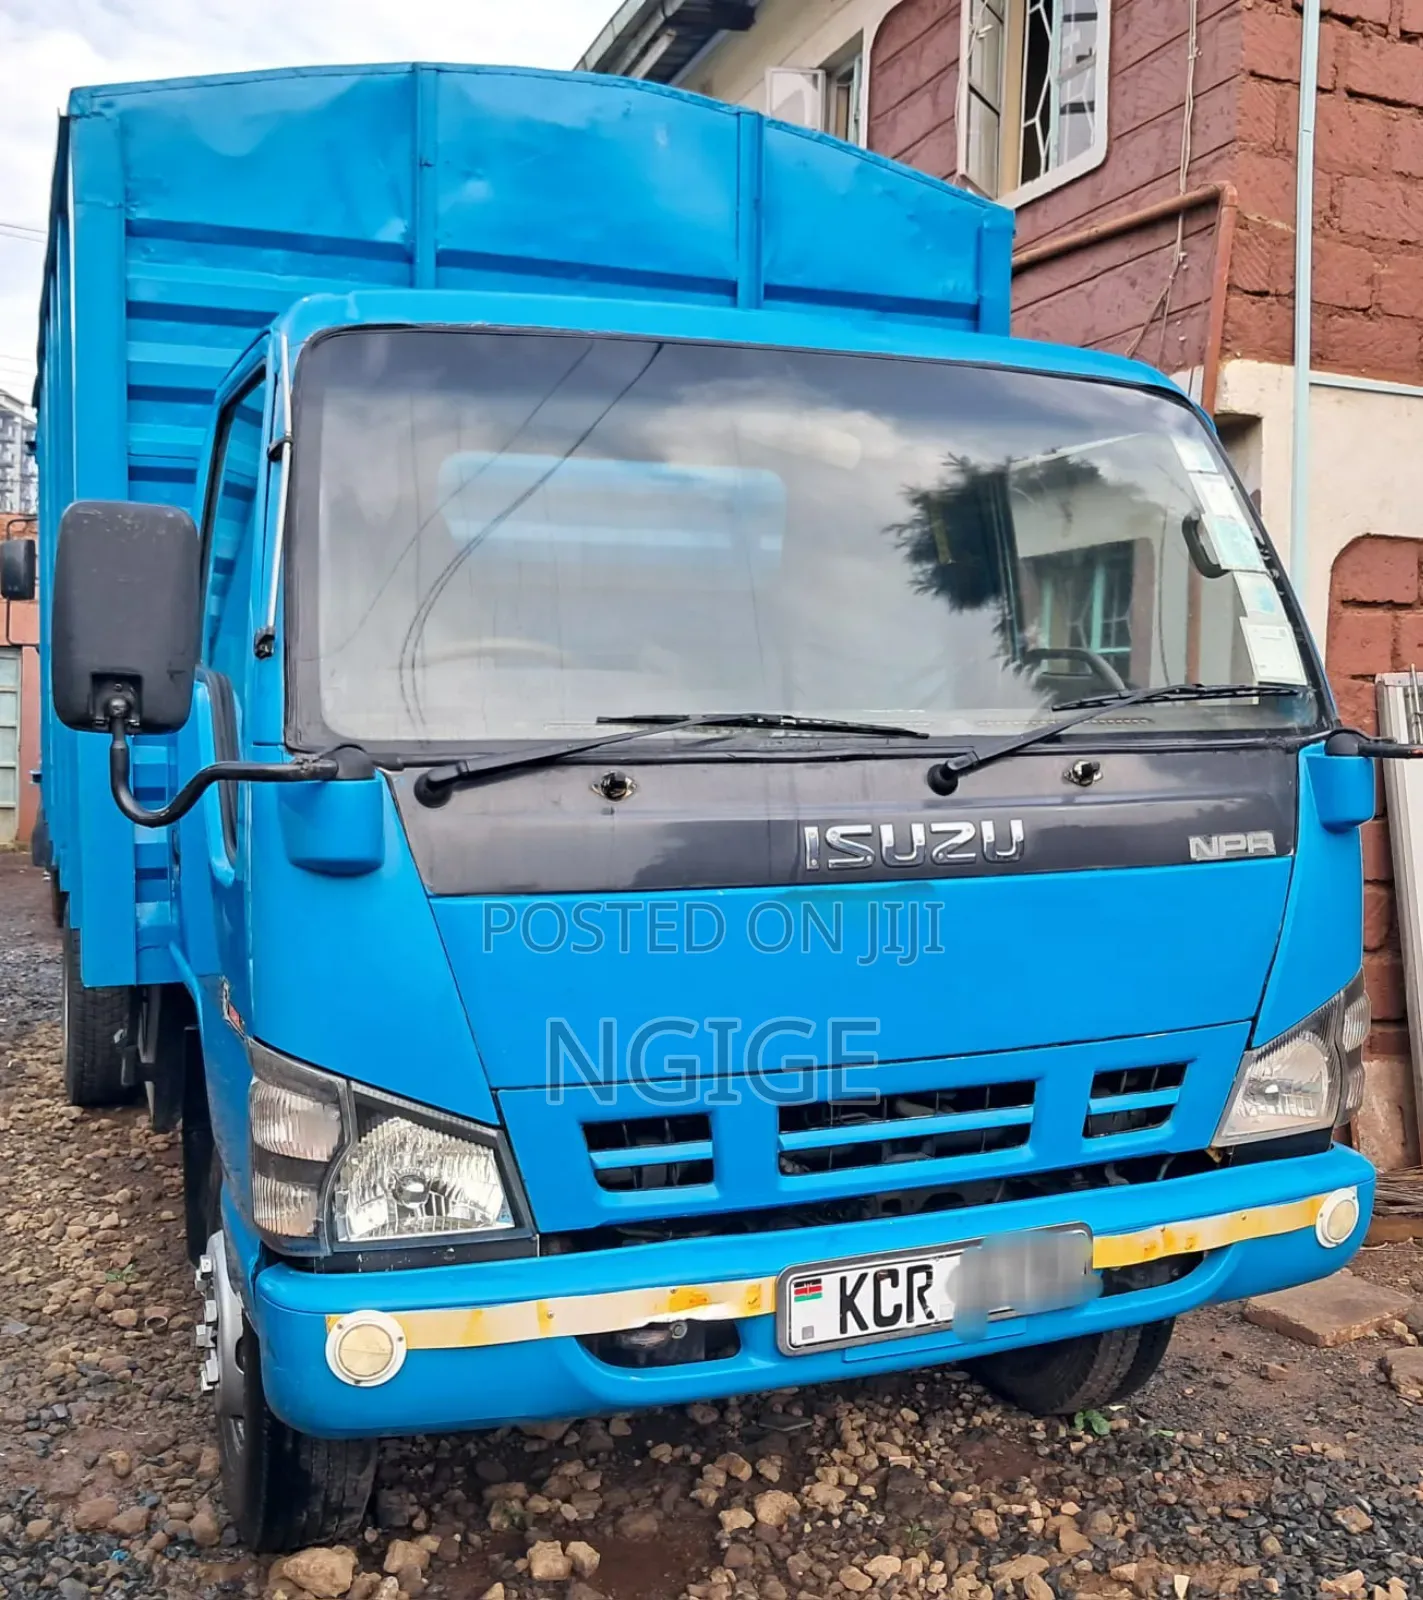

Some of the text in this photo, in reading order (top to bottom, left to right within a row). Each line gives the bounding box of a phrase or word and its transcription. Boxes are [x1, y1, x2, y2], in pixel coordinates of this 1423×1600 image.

[804, 819, 1025, 870] ISUZU
[1188, 830, 1276, 861] NPR
[839, 1264, 934, 1334] KCR
